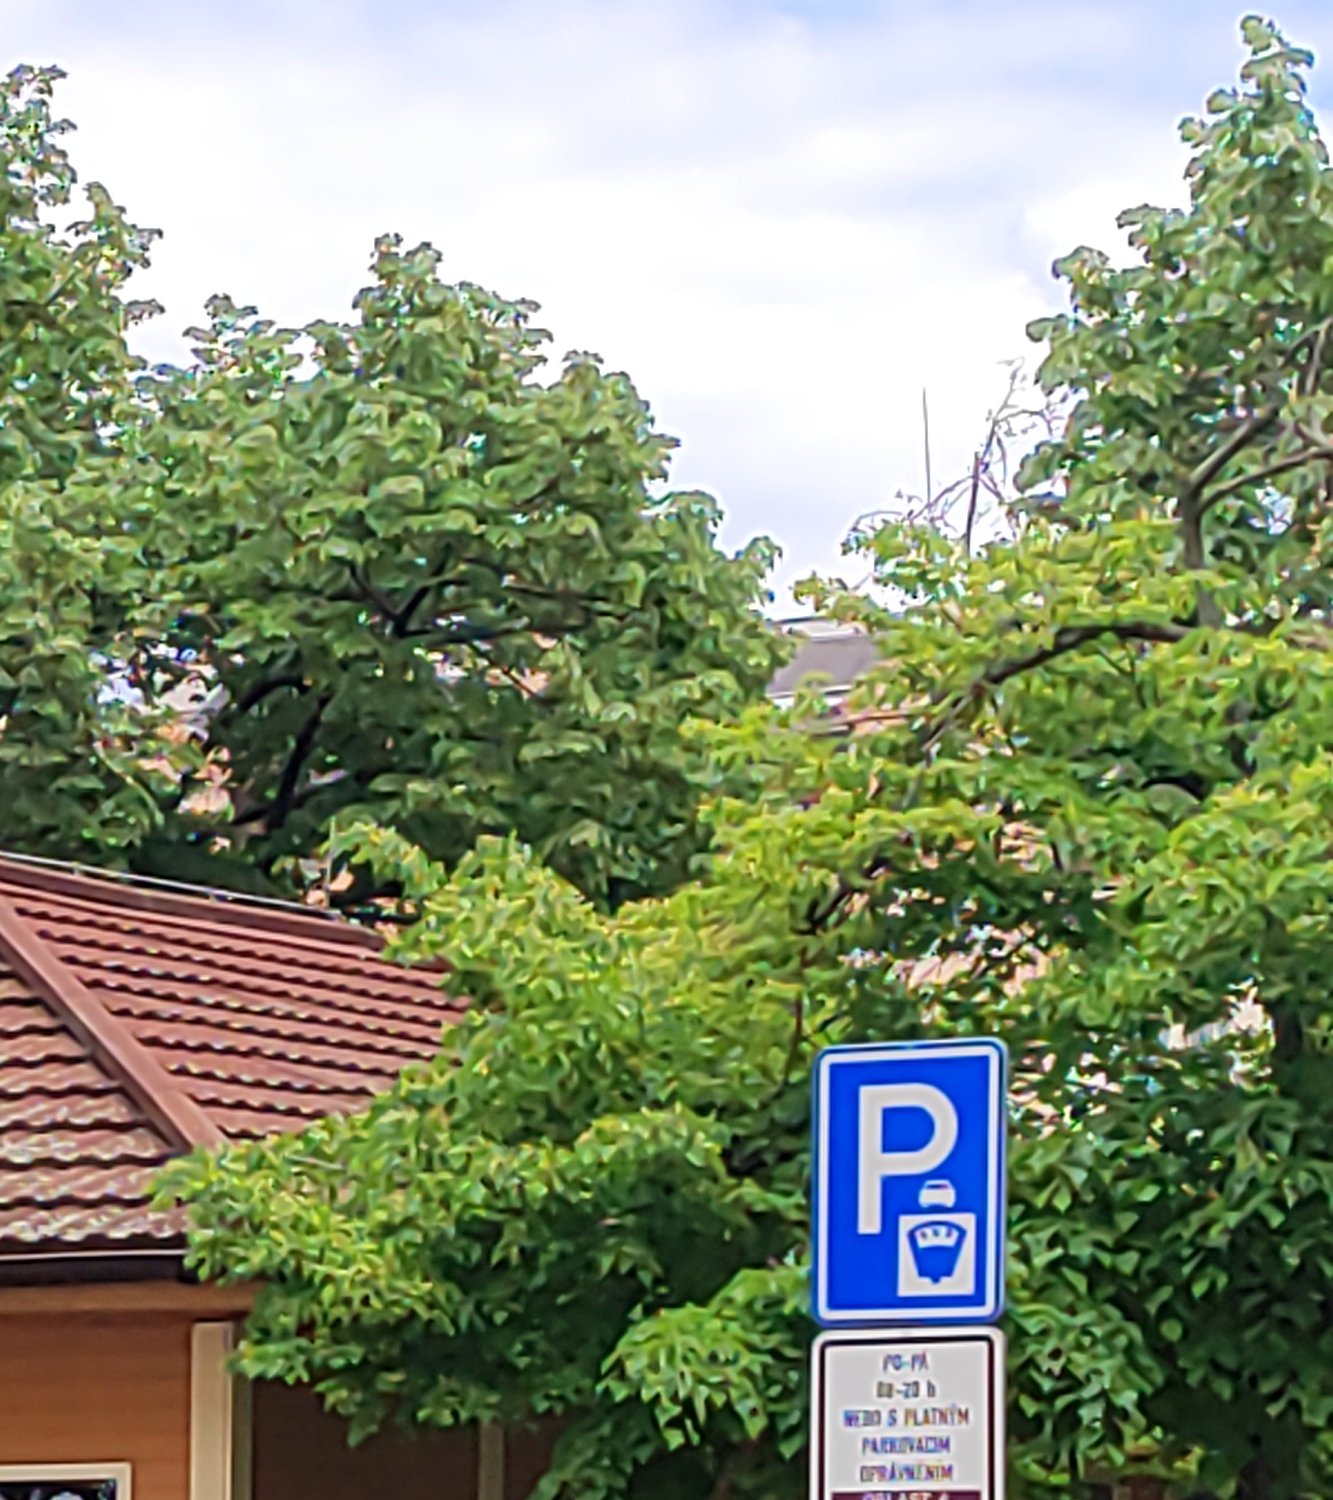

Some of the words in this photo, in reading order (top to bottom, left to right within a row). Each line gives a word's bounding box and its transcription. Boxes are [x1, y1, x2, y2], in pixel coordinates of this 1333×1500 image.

[858, 1082, 958, 1234] P
[888, 1409, 897, 1426] S
[904, 1403, 969, 1426] PLATNÝM
